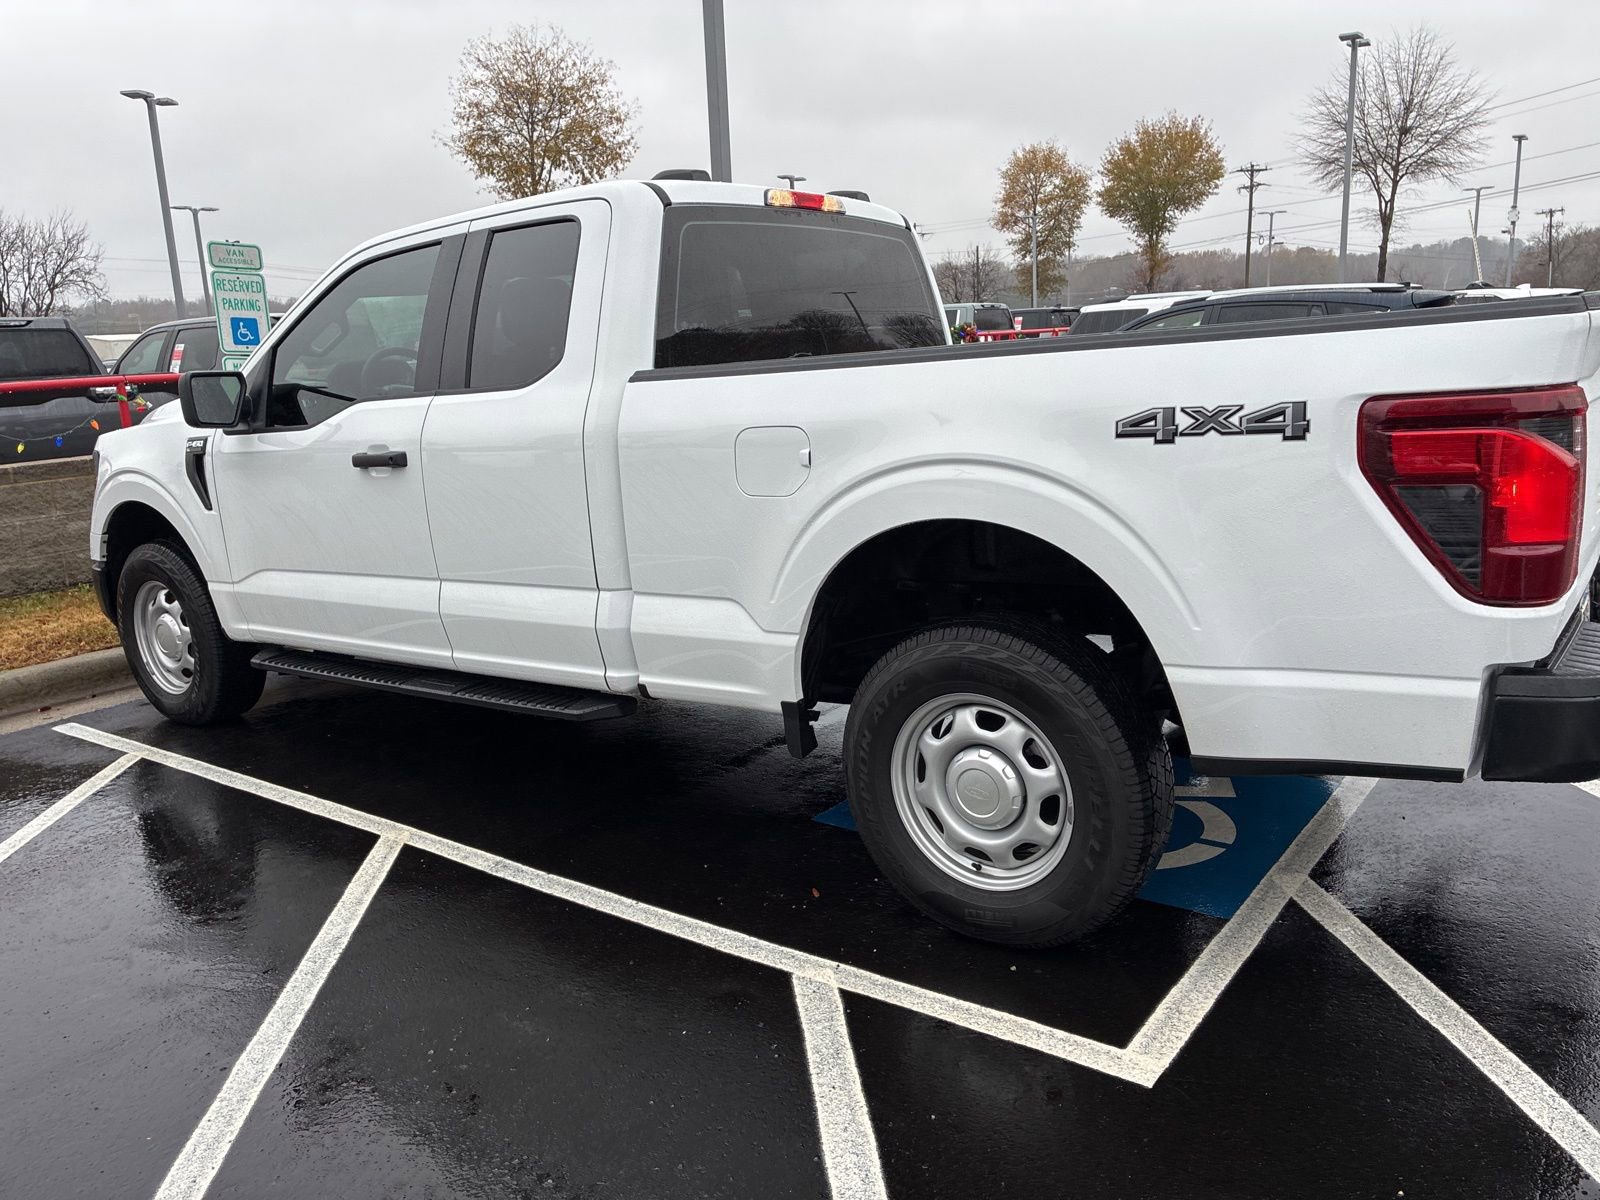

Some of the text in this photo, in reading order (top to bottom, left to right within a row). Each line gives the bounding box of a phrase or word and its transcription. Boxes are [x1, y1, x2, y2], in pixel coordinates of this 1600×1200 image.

[225, 248, 245, 258] VAN
[217, 256, 255, 266] ACCESSIBLE
[216, 278, 262, 294] RESERVED
[222, 297, 261, 312] PARKING
[1115, 401, 1310, 444] 4X4
